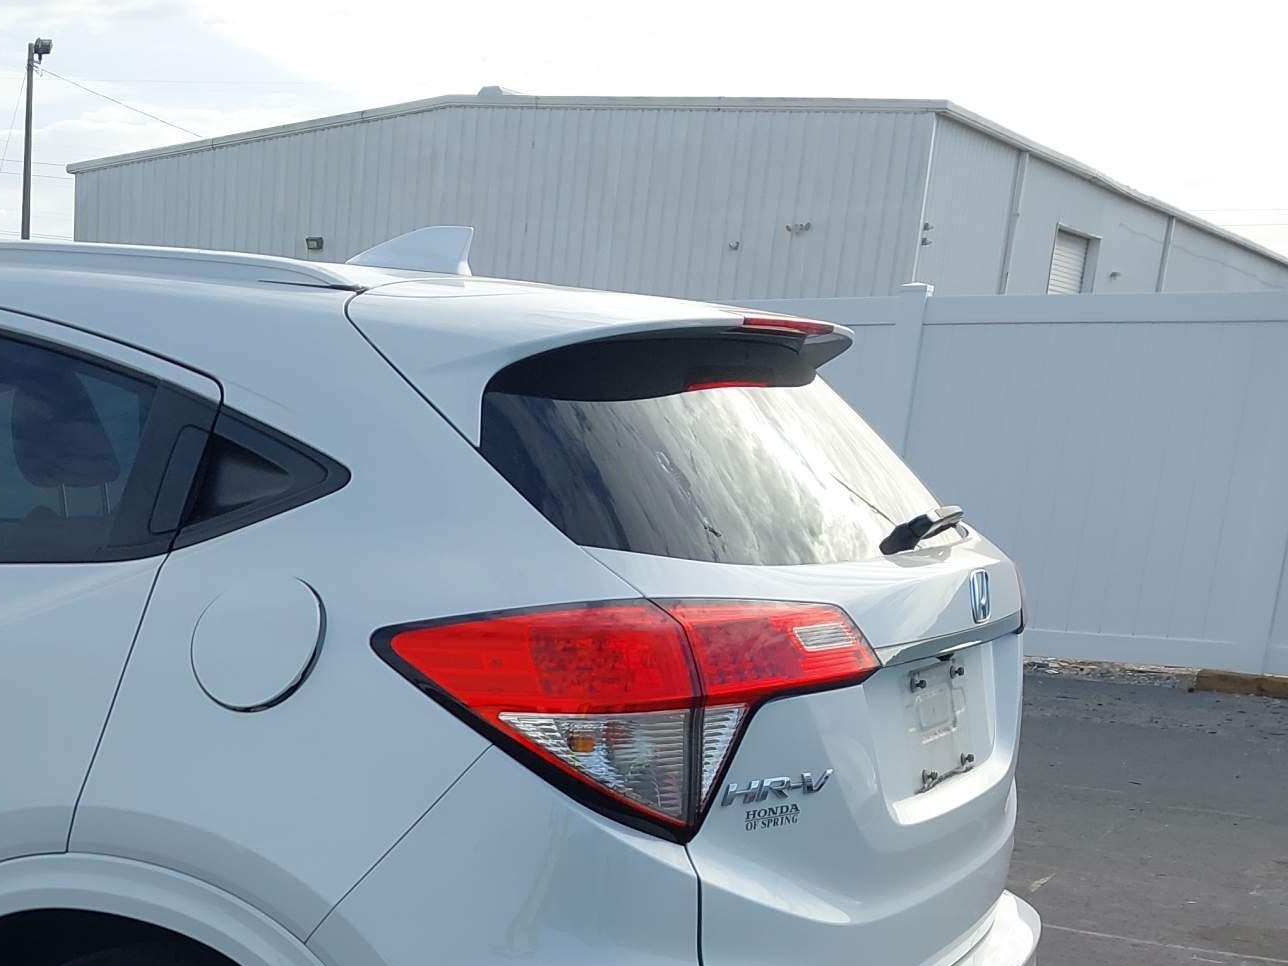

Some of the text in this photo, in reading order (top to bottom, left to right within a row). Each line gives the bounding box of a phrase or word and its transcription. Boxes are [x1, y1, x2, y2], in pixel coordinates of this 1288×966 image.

[720, 768, 834, 807] HR-V
[745, 803, 800, 821] HONDA
[745, 814, 798, 831] OF SPRING
